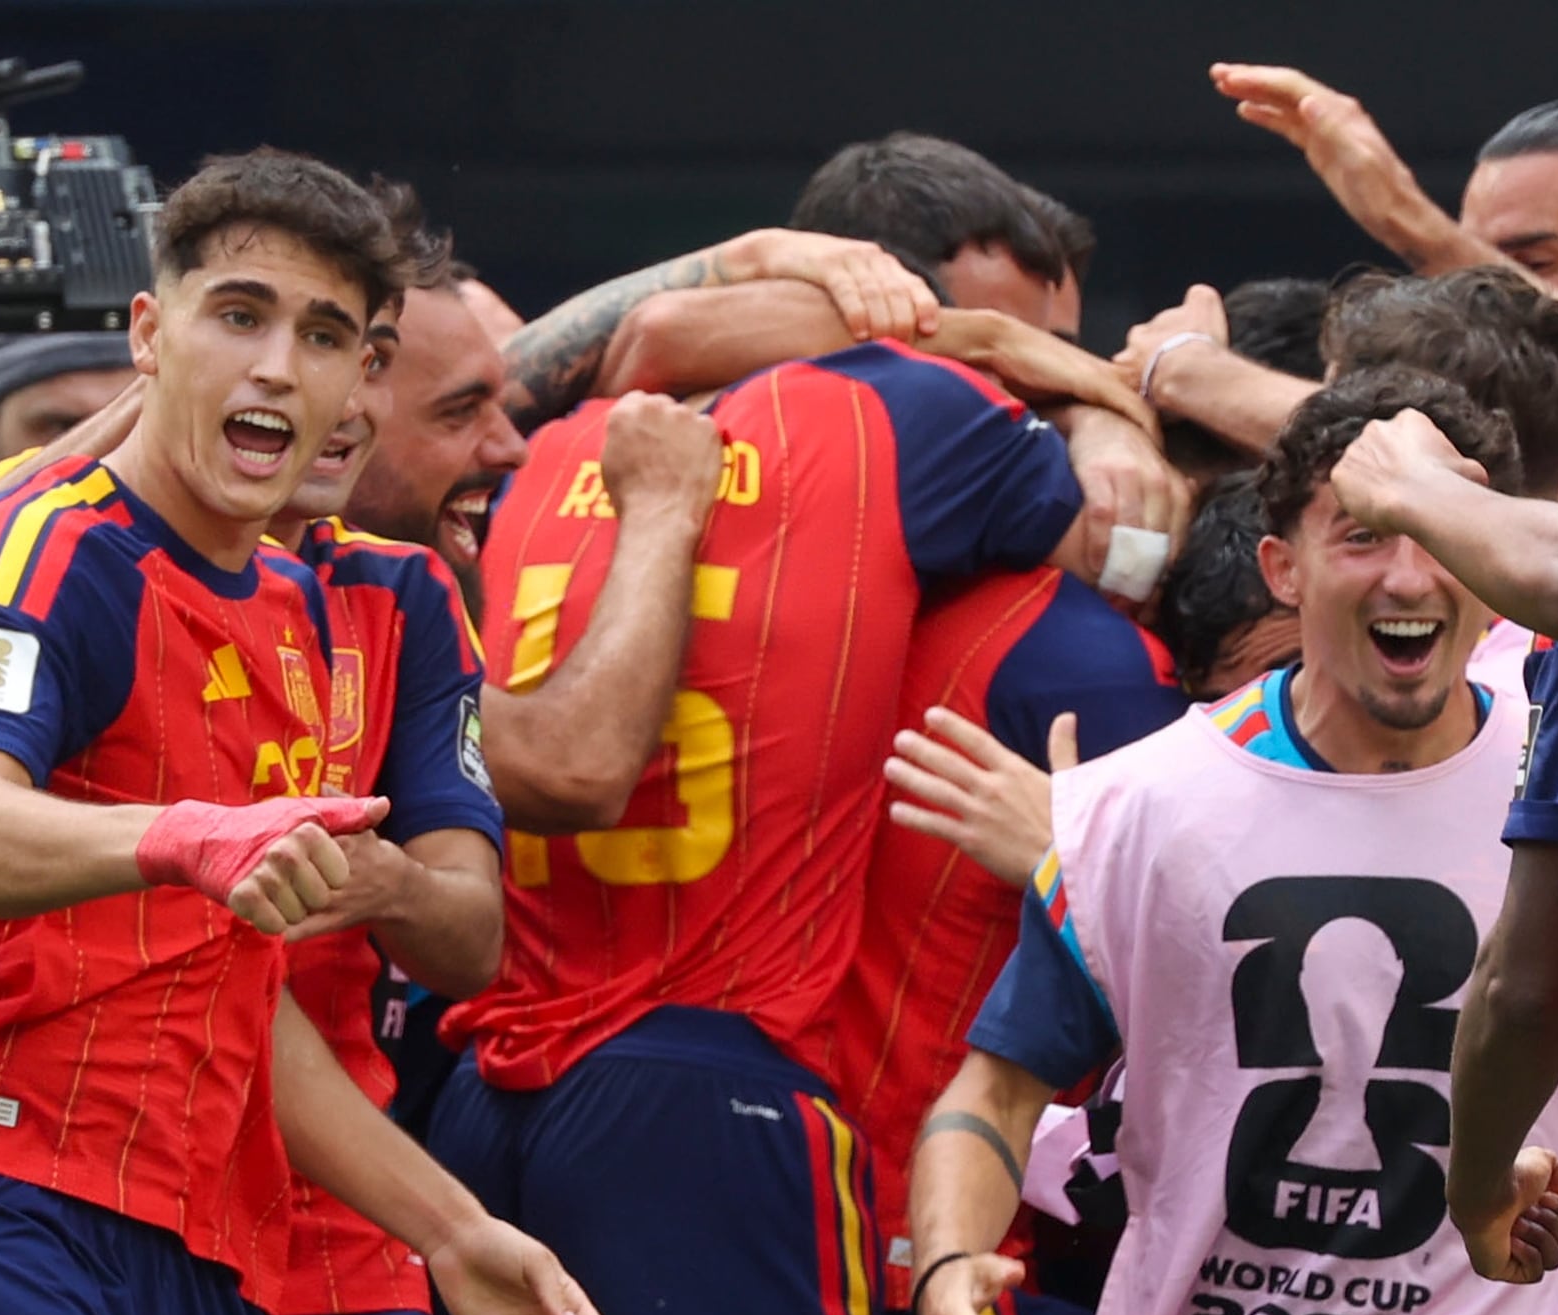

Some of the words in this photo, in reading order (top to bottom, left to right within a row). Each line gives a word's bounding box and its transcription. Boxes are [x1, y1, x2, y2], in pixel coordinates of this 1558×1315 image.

[1273, 1180, 1383, 1231] FIFA
[1200, 1256, 1335, 1301] WORLD
[1344, 1278, 1432, 1313] CUP
